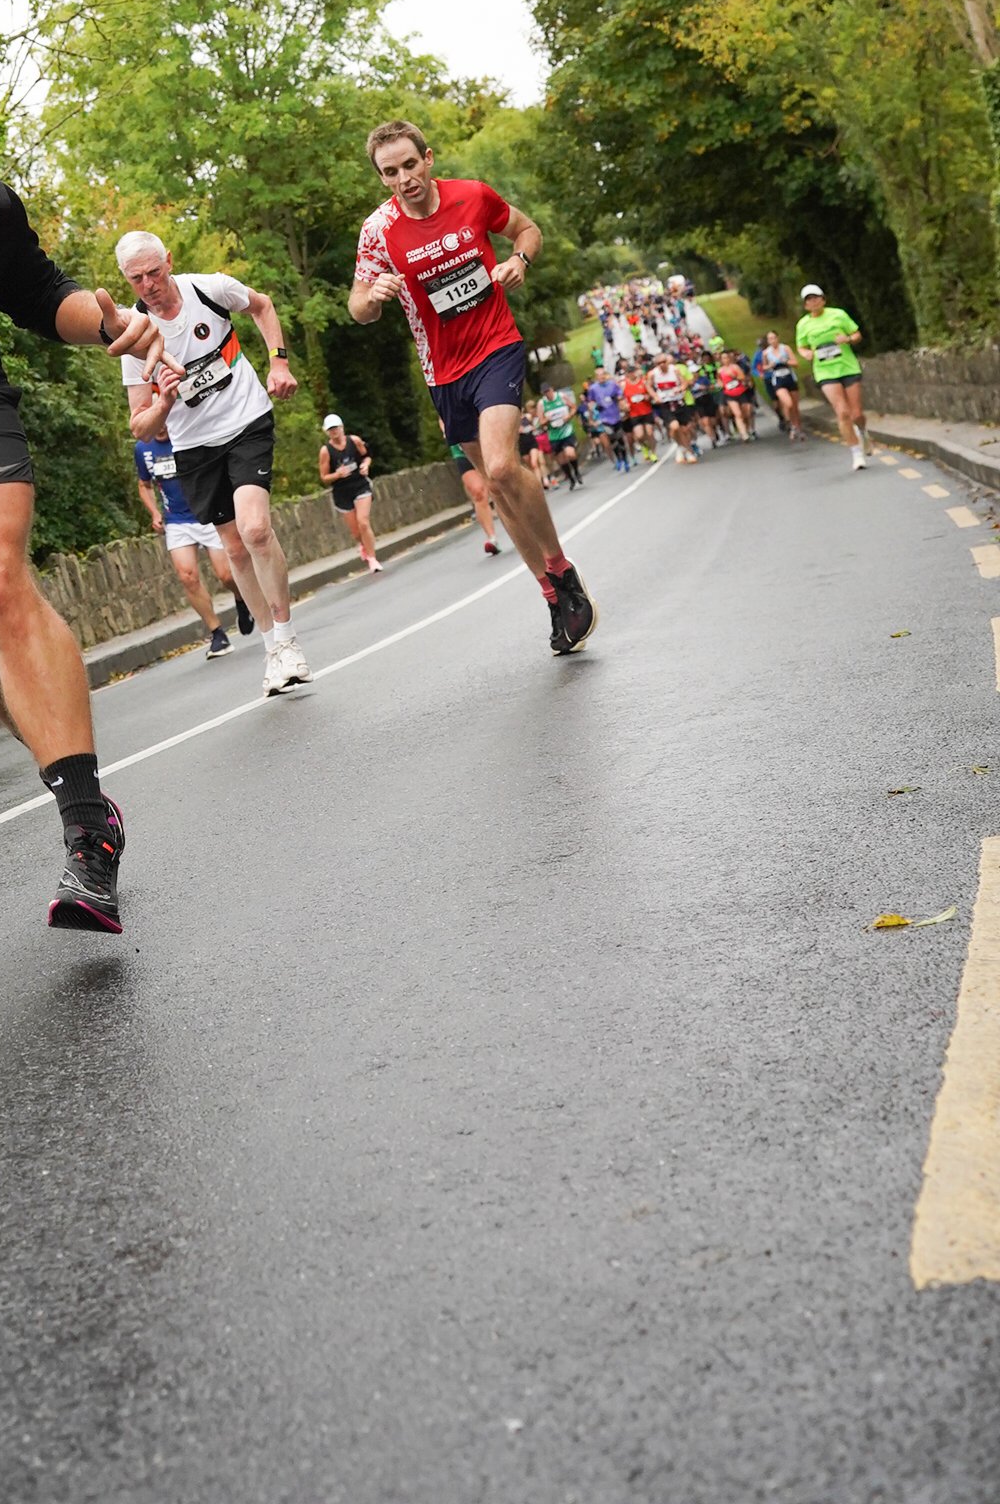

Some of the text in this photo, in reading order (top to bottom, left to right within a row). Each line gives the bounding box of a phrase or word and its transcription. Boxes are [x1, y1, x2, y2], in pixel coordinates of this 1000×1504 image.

[406, 239, 440, 258] CORK CITY
[408, 246, 442, 264] MARATHON
[417, 248, 479, 280] HALF MARATHON
[441, 262, 476, 284] RACE SERIES
[445, 278, 478, 301] 1129
[186, 365, 200, 375] RACE
[193, 370, 214, 388] 633
